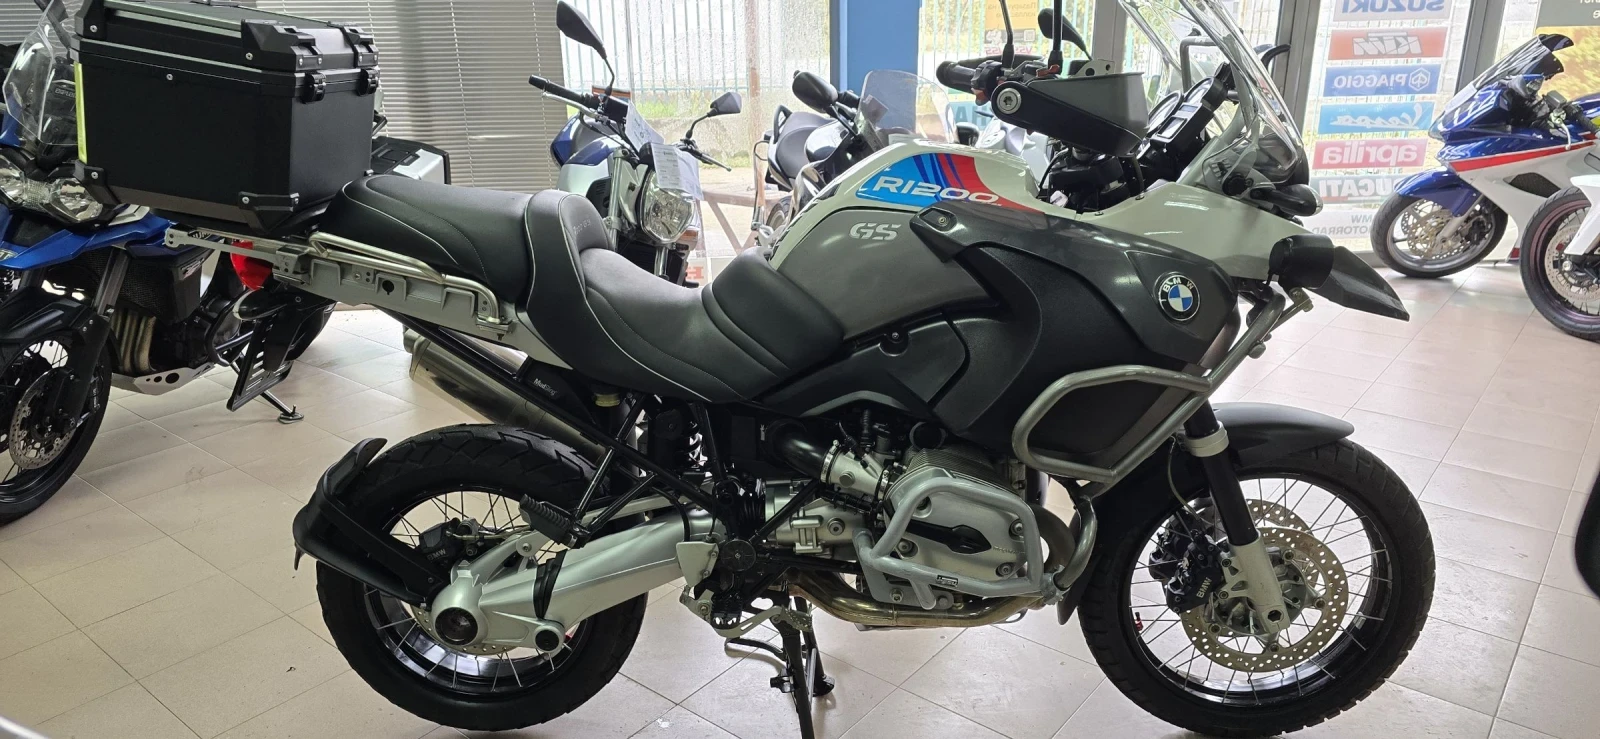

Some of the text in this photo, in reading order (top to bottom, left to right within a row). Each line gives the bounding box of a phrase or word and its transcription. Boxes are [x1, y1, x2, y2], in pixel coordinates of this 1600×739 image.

[874, 175, 999, 203] R1200
[849, 222, 901, 241] GS
[1162, 277, 1194, 293] BMW
[1196, 576, 1213, 599] BMW
